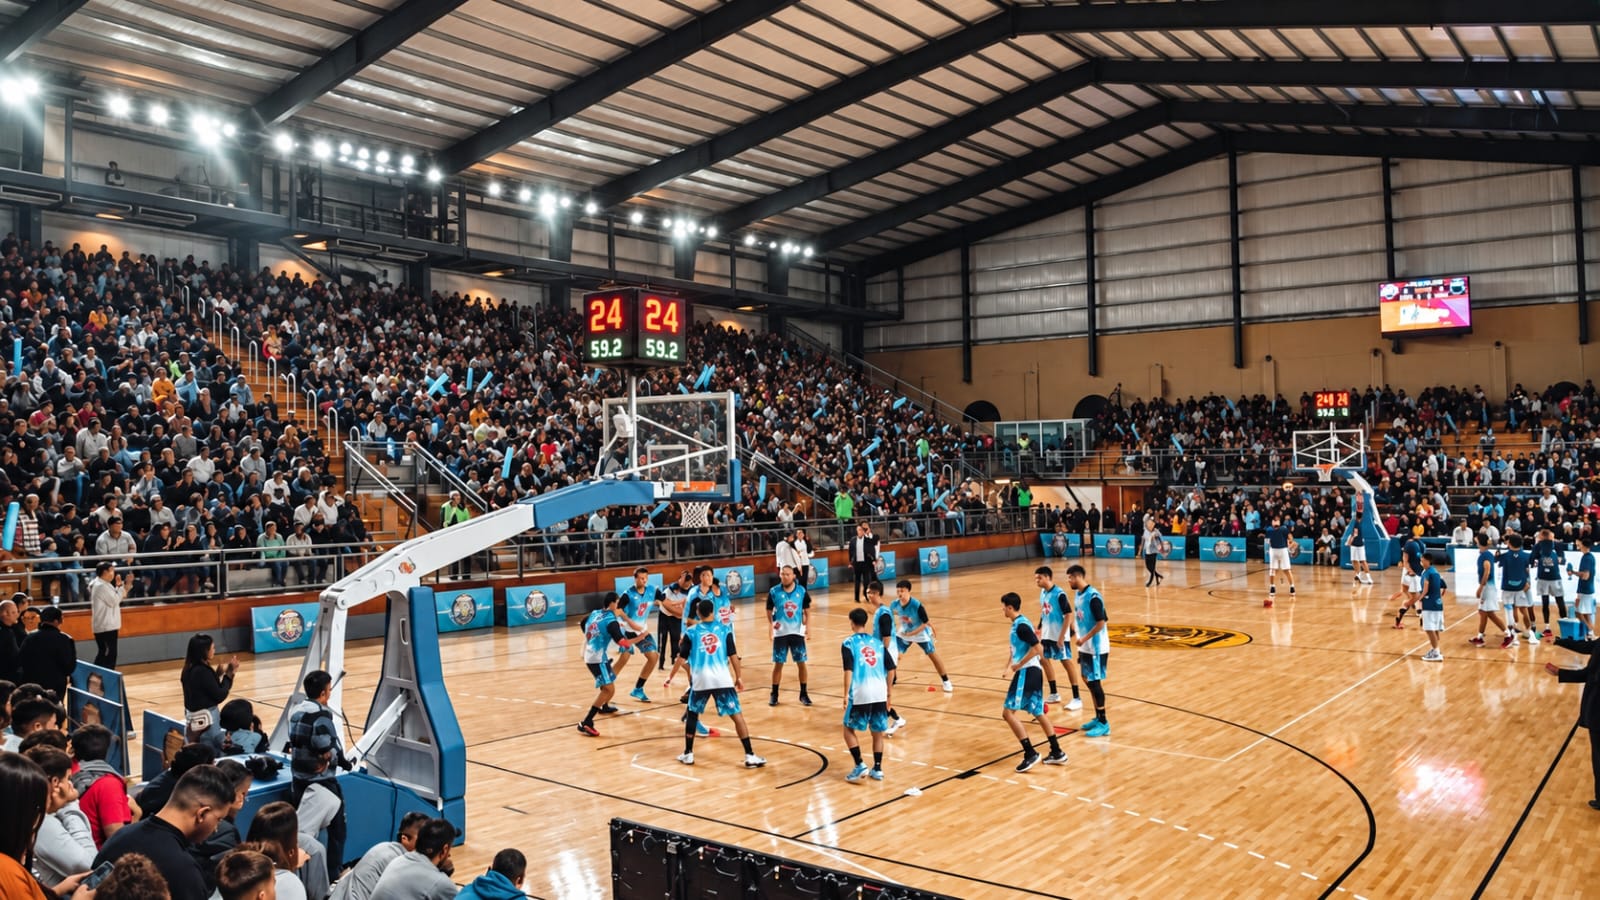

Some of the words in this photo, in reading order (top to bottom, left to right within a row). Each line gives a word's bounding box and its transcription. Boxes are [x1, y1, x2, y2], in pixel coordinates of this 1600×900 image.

[591, 298, 622, 331] 24
[646, 299, 679, 333] 24
[591, 338, 622, 358] 59.2
[646, 338, 678, 359] 59.2
